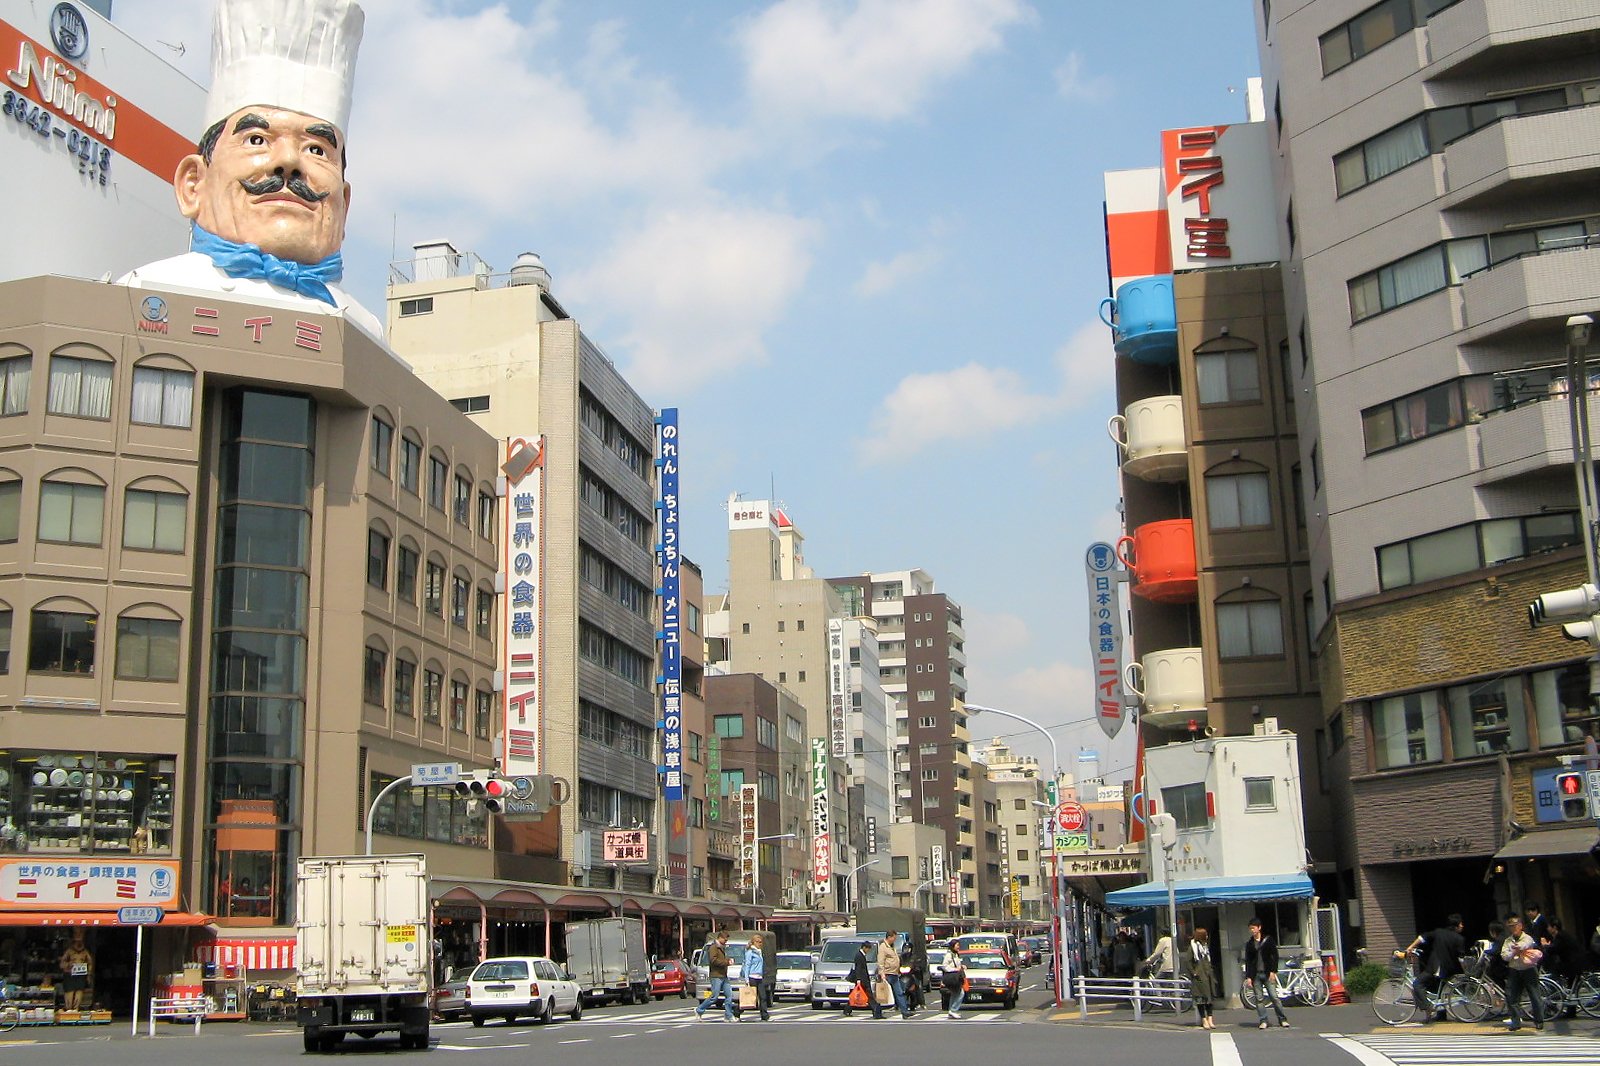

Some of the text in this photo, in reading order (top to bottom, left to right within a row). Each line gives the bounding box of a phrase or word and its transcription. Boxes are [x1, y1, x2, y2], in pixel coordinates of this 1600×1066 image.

[7, 41, 117, 140] Niimi
[1180, 131, 1231, 259] ニイミ
[192, 307, 323, 351] ニイミ
[662, 425, 681, 787] のれん・ちょうちん・メニュー・伝票の浅草屋
[1096, 577, 1120, 719] 日本の食器 ニイミ
[509, 653, 535, 760] ニイミ
[1060, 813, 1081, 823] 消火栓
[607, 832, 641, 844] かっぱ橋
[1055, 835, 1087, 847] カジワラ
[615, 846, 644, 859] 道具街
[18, 866, 137, 878] 世界の食器・調理器具
[1071, 859, 1142, 872] かっぱ橋道具街
[16, 879, 137, 899] ニイミ
